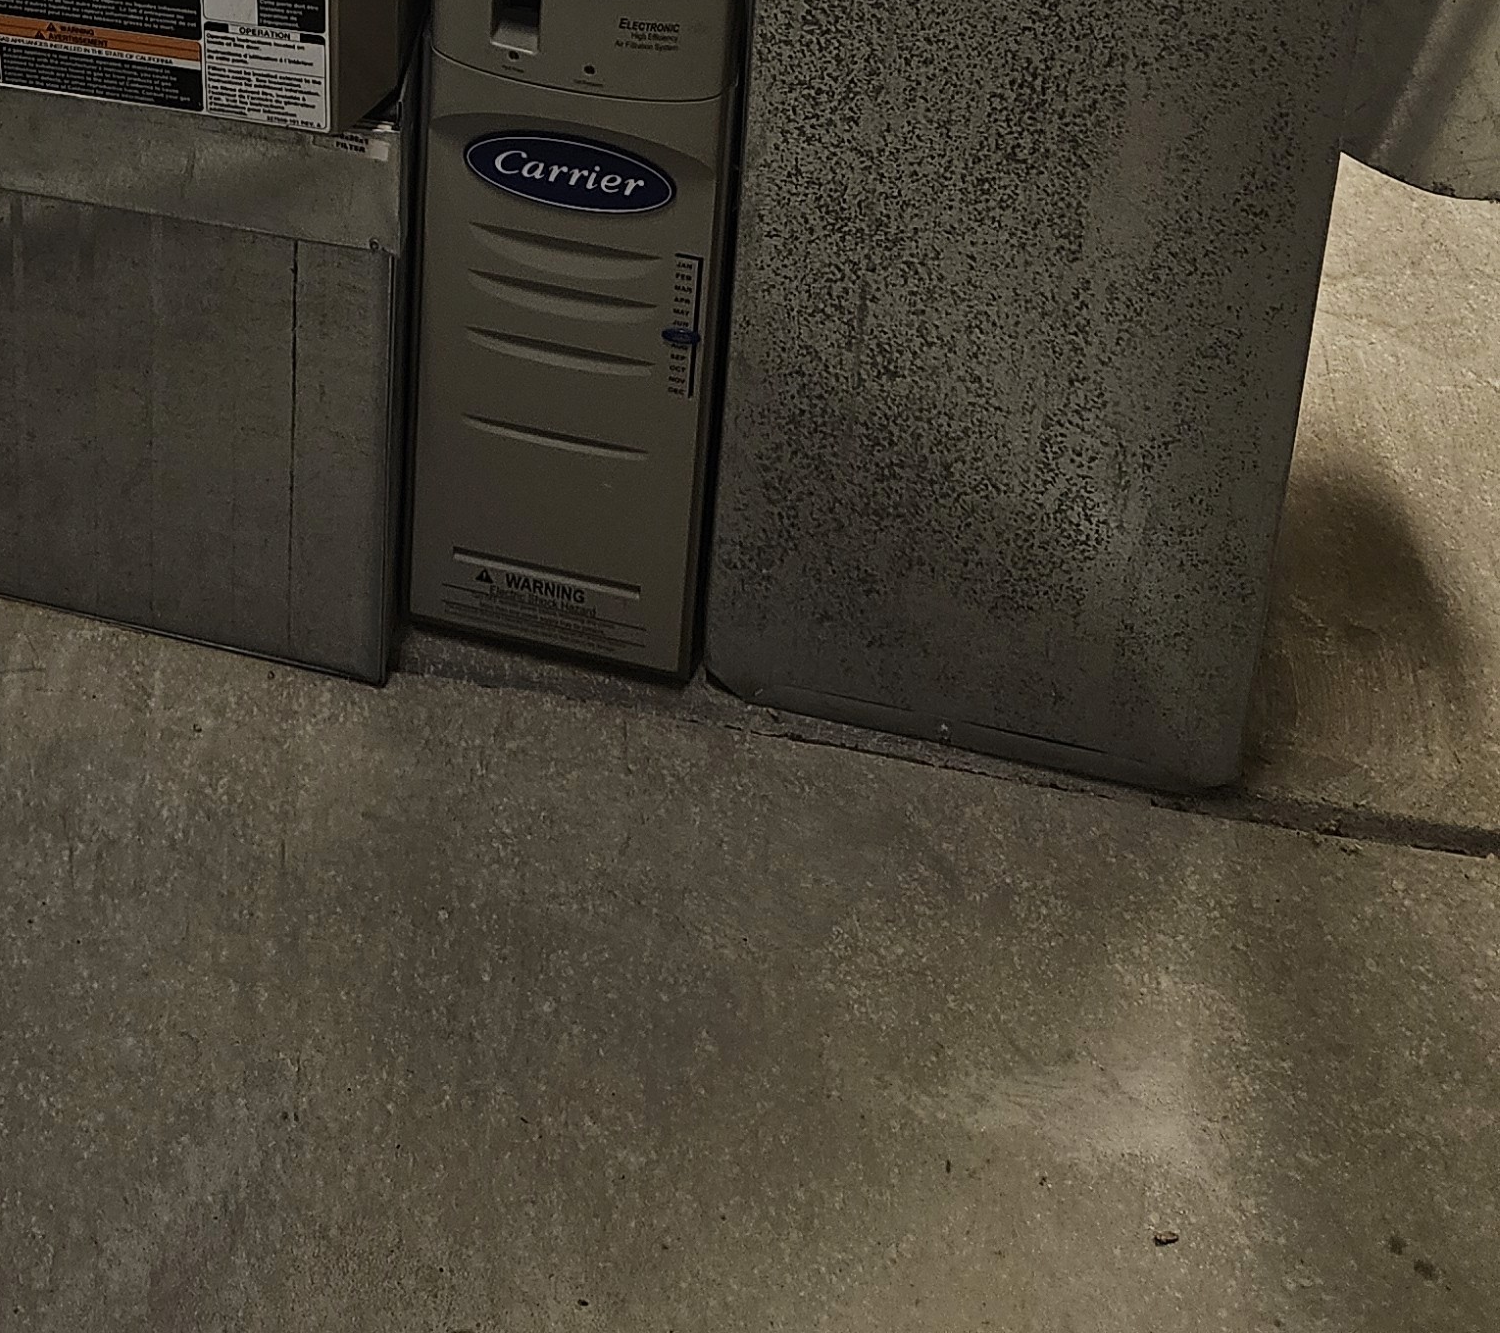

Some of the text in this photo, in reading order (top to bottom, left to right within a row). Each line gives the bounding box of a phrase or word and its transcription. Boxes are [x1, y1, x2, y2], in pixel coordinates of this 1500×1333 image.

[618, 17, 680, 33] ELECTRONIC
[239, 26, 291, 41] OPERATION
[631, 33, 647, 42] High
[335, 141, 366, 153] FILTER
[494, 149, 645, 197] Carrier
[506, 573, 585, 604] WARNING
